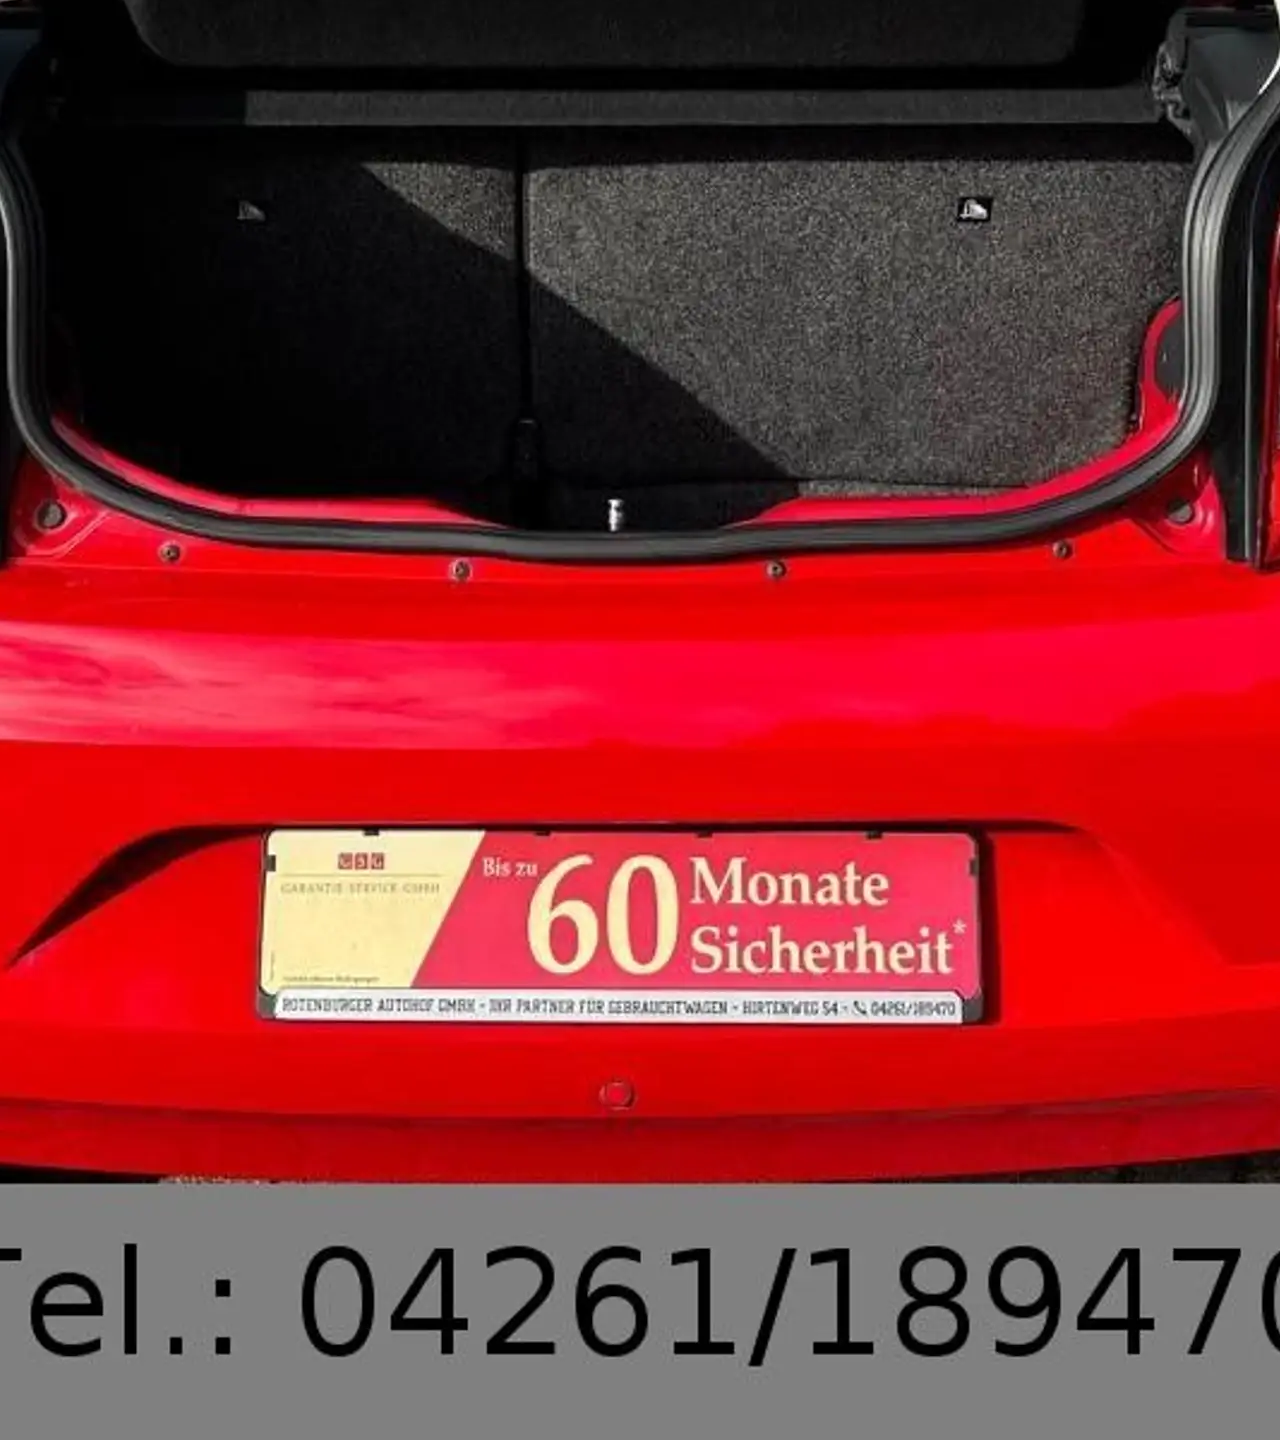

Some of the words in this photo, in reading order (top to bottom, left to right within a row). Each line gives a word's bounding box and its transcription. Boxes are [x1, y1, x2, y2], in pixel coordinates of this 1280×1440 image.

[483, 856, 512, 878] Bis
[515, 862, 538, 878] zu
[689, 856, 890, 907] Monate
[527, 853, 680, 976] 60
[282, 997, 373, 1012] ROTENBURGER
[377, 997, 435, 1012] AUTOHOF
[516, 997, 576, 1014] PARTNER
[607, 999, 728, 1015] GEBRAUCHTWAGEN
